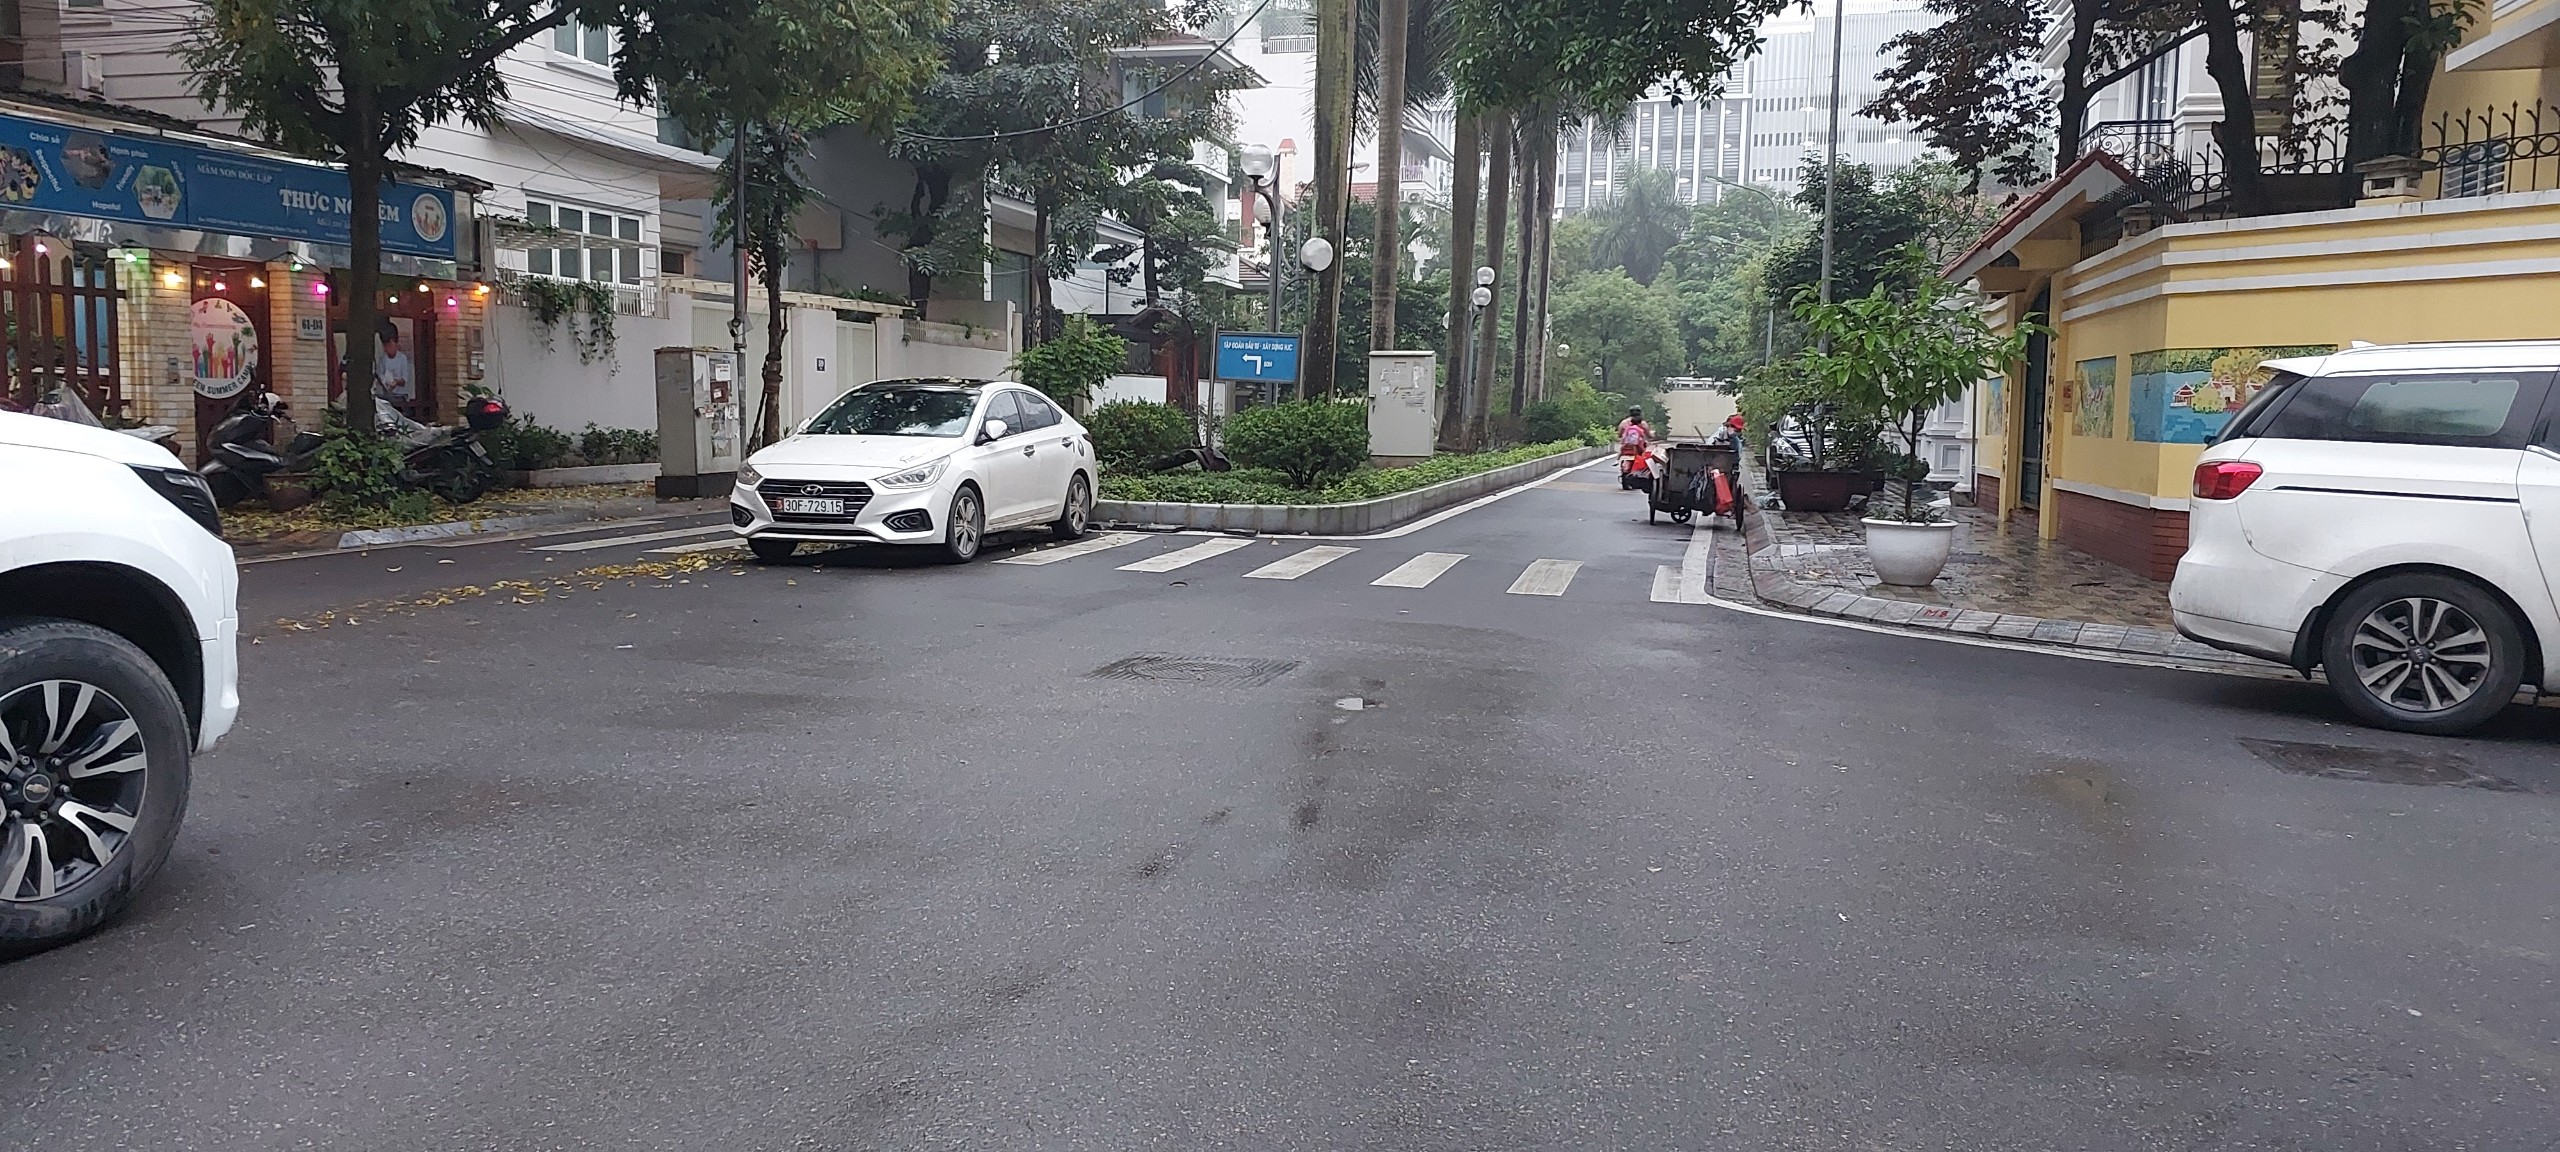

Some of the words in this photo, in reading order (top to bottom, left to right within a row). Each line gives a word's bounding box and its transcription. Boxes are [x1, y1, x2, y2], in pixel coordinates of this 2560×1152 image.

[279, 188, 329, 216] THỰC
[206, 381, 238, 395] SUMMER
[784, 499, 843, 513] 30F-729.15
